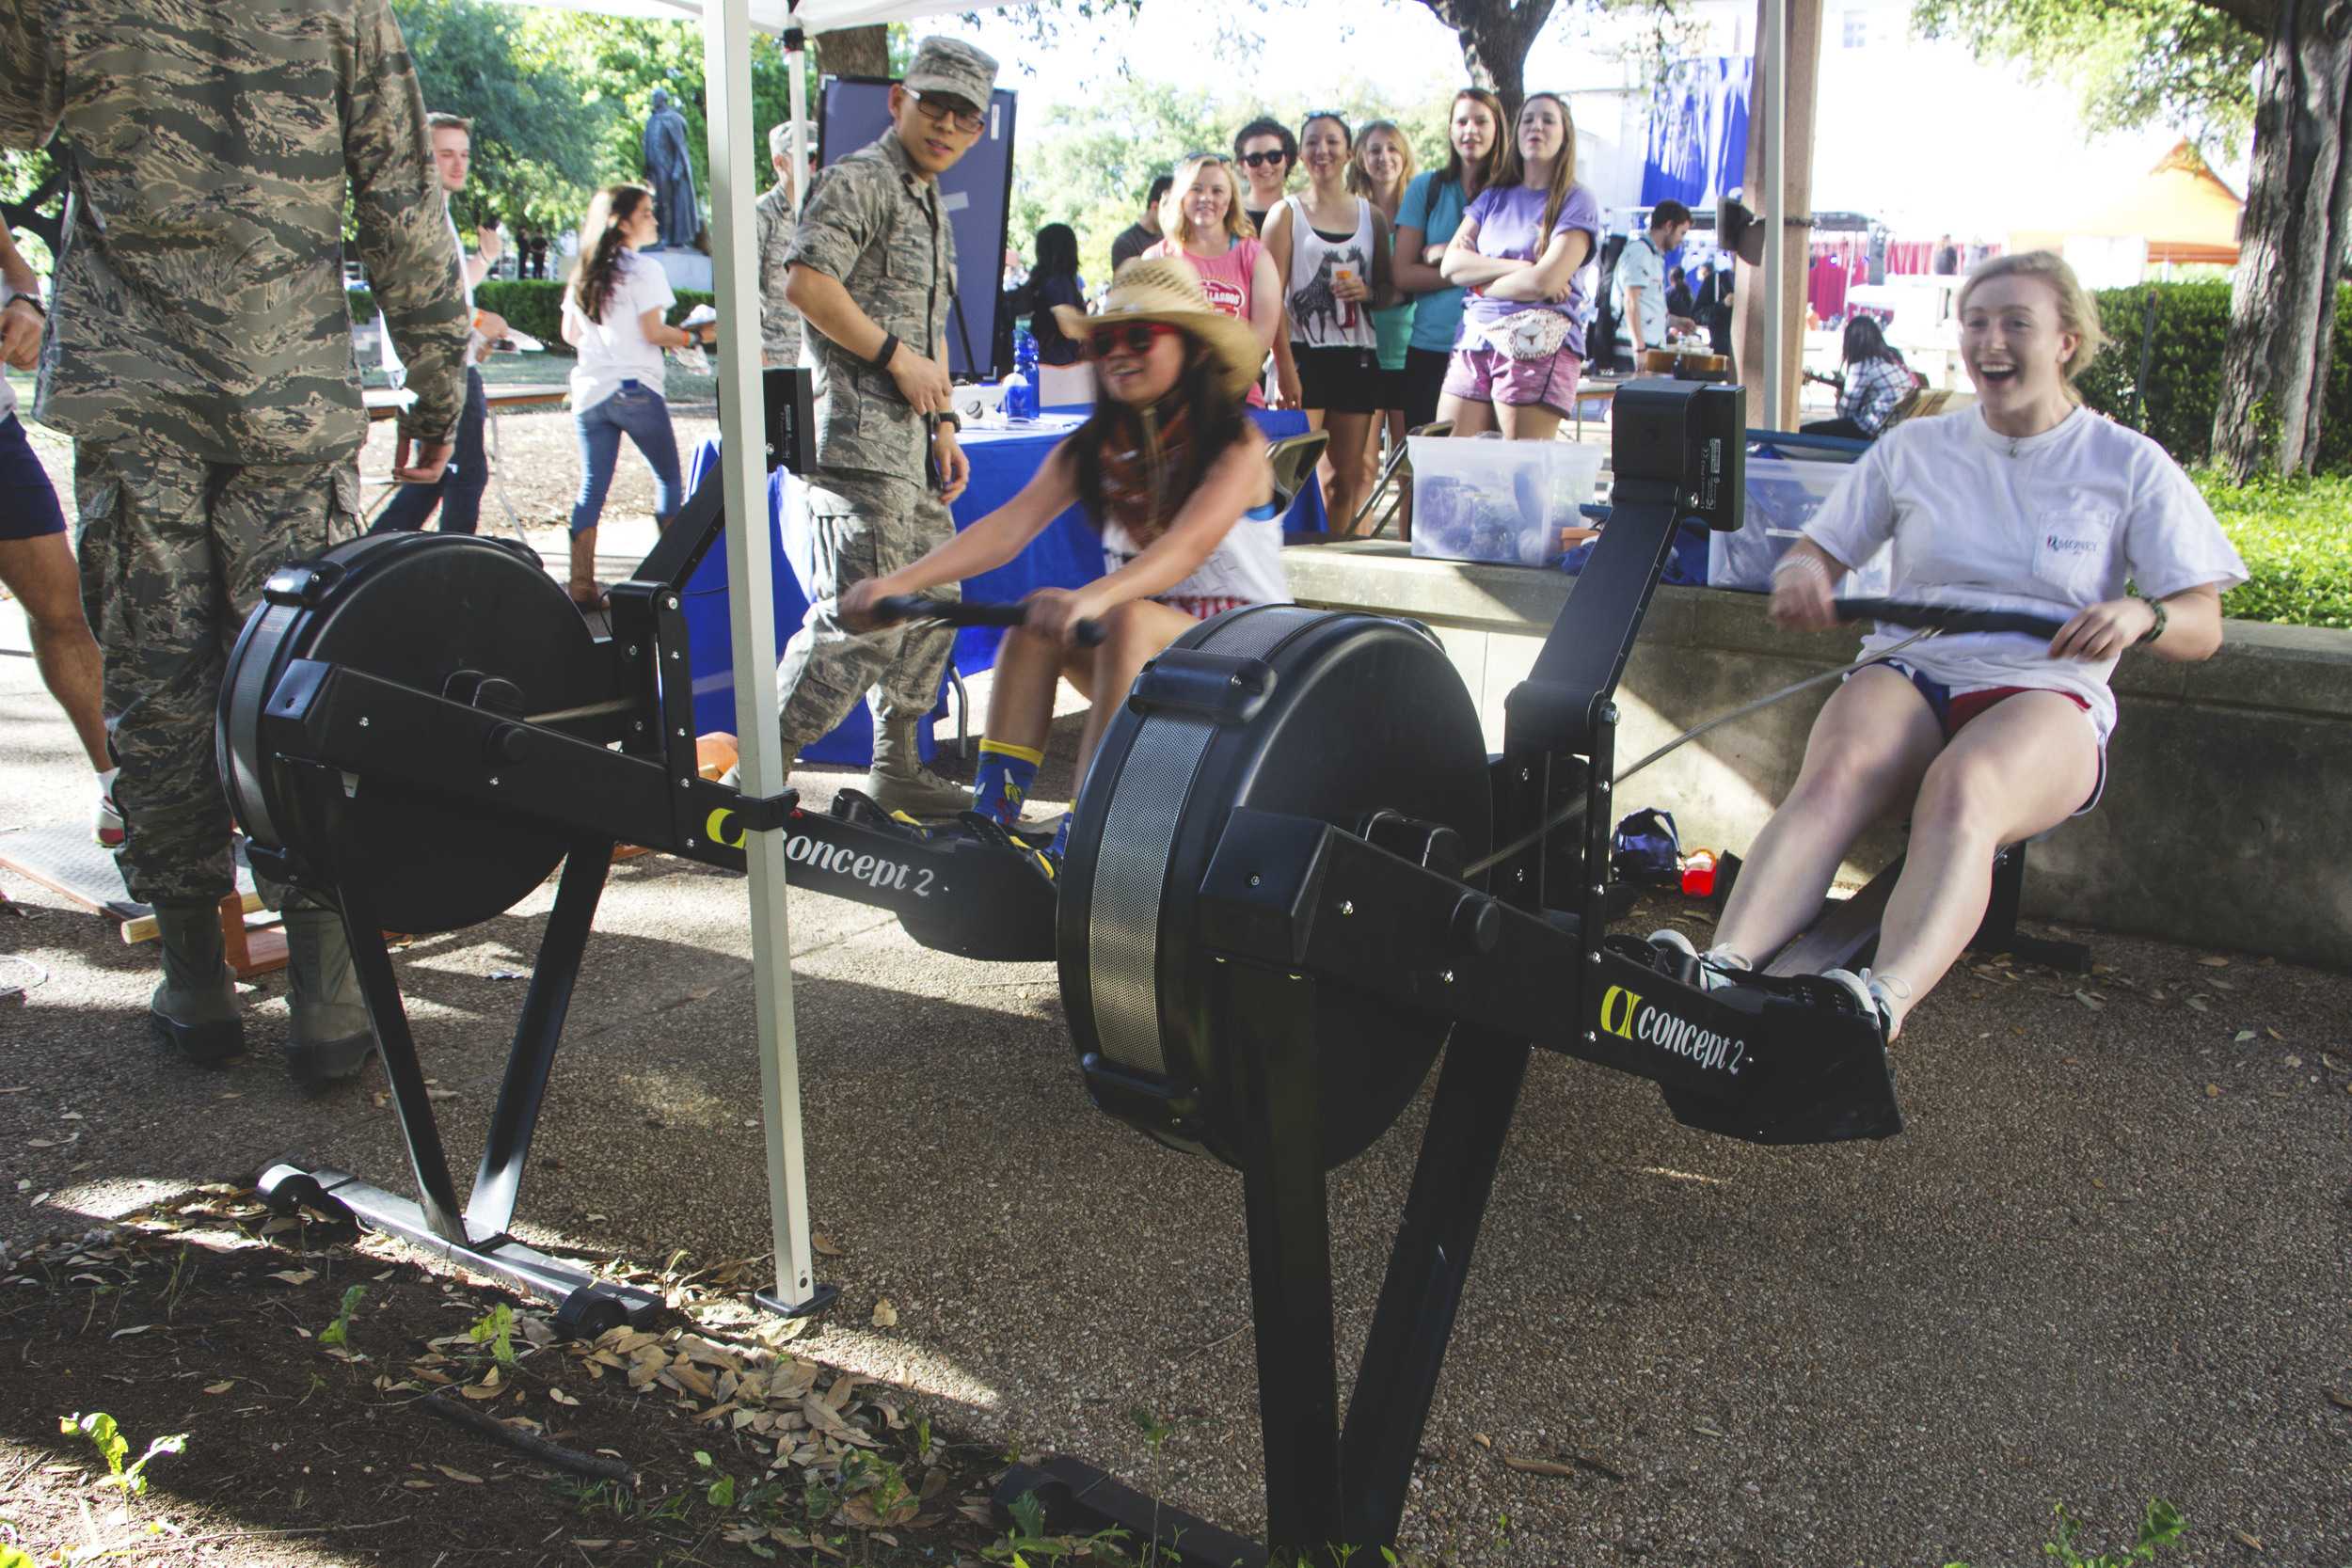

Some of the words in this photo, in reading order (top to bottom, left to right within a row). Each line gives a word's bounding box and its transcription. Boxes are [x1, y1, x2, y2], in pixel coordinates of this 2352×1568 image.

[783, 831, 911, 890] oncept
[913, 868, 934, 896] 2
[1638, 1006, 1730, 1069] concept
[1729, 1040, 1744, 1075] 2
